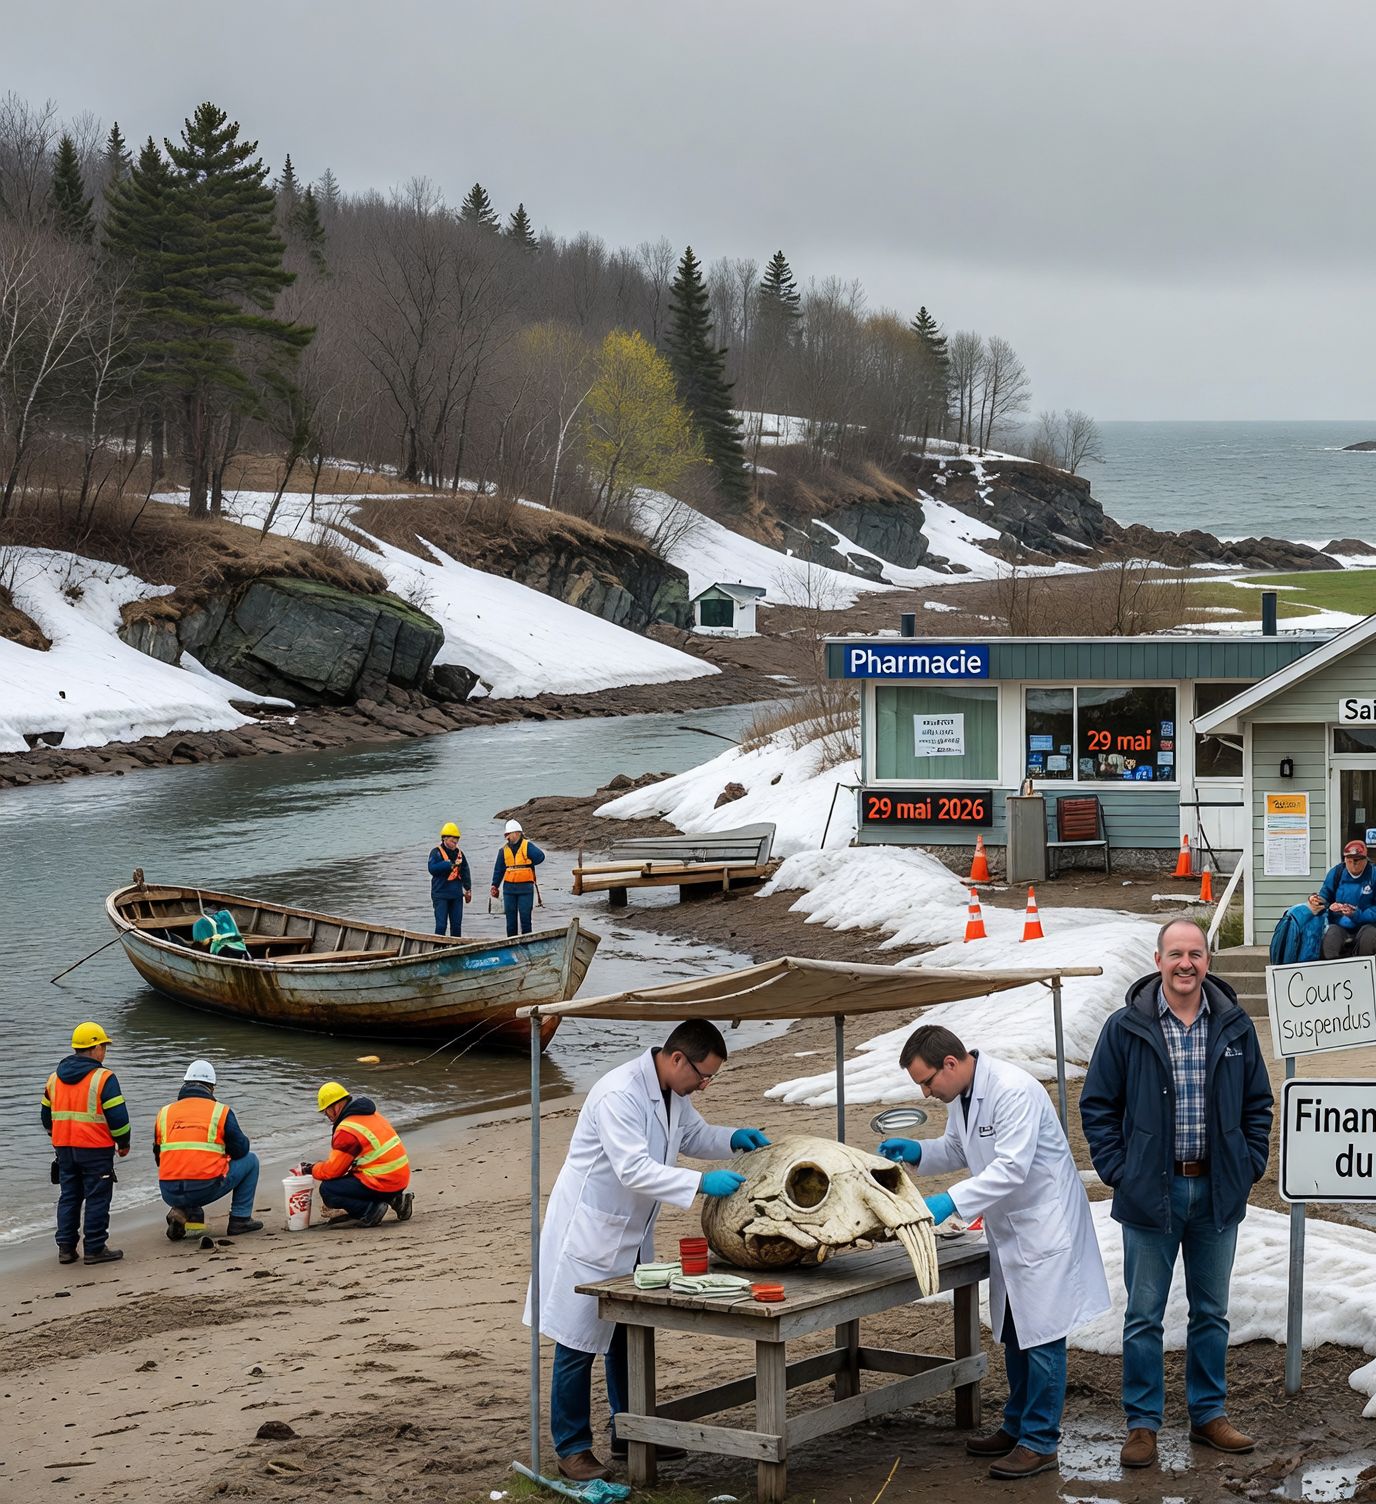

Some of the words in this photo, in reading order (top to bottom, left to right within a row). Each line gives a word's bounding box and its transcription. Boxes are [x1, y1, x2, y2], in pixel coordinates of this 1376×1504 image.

[851, 649, 982, 674] Pharmacie
[1088, 730, 1112, 750] 29
[1117, 729, 1152, 751] mai
[868, 798, 892, 819] 29
[896, 799, 932, 819] mai
[938, 798, 984, 820] 2026
[1287, 971, 1353, 1008] Cours
[1282, 1004, 1371, 1047] suspendus
[1335, 1144, 1373, 1178] du
